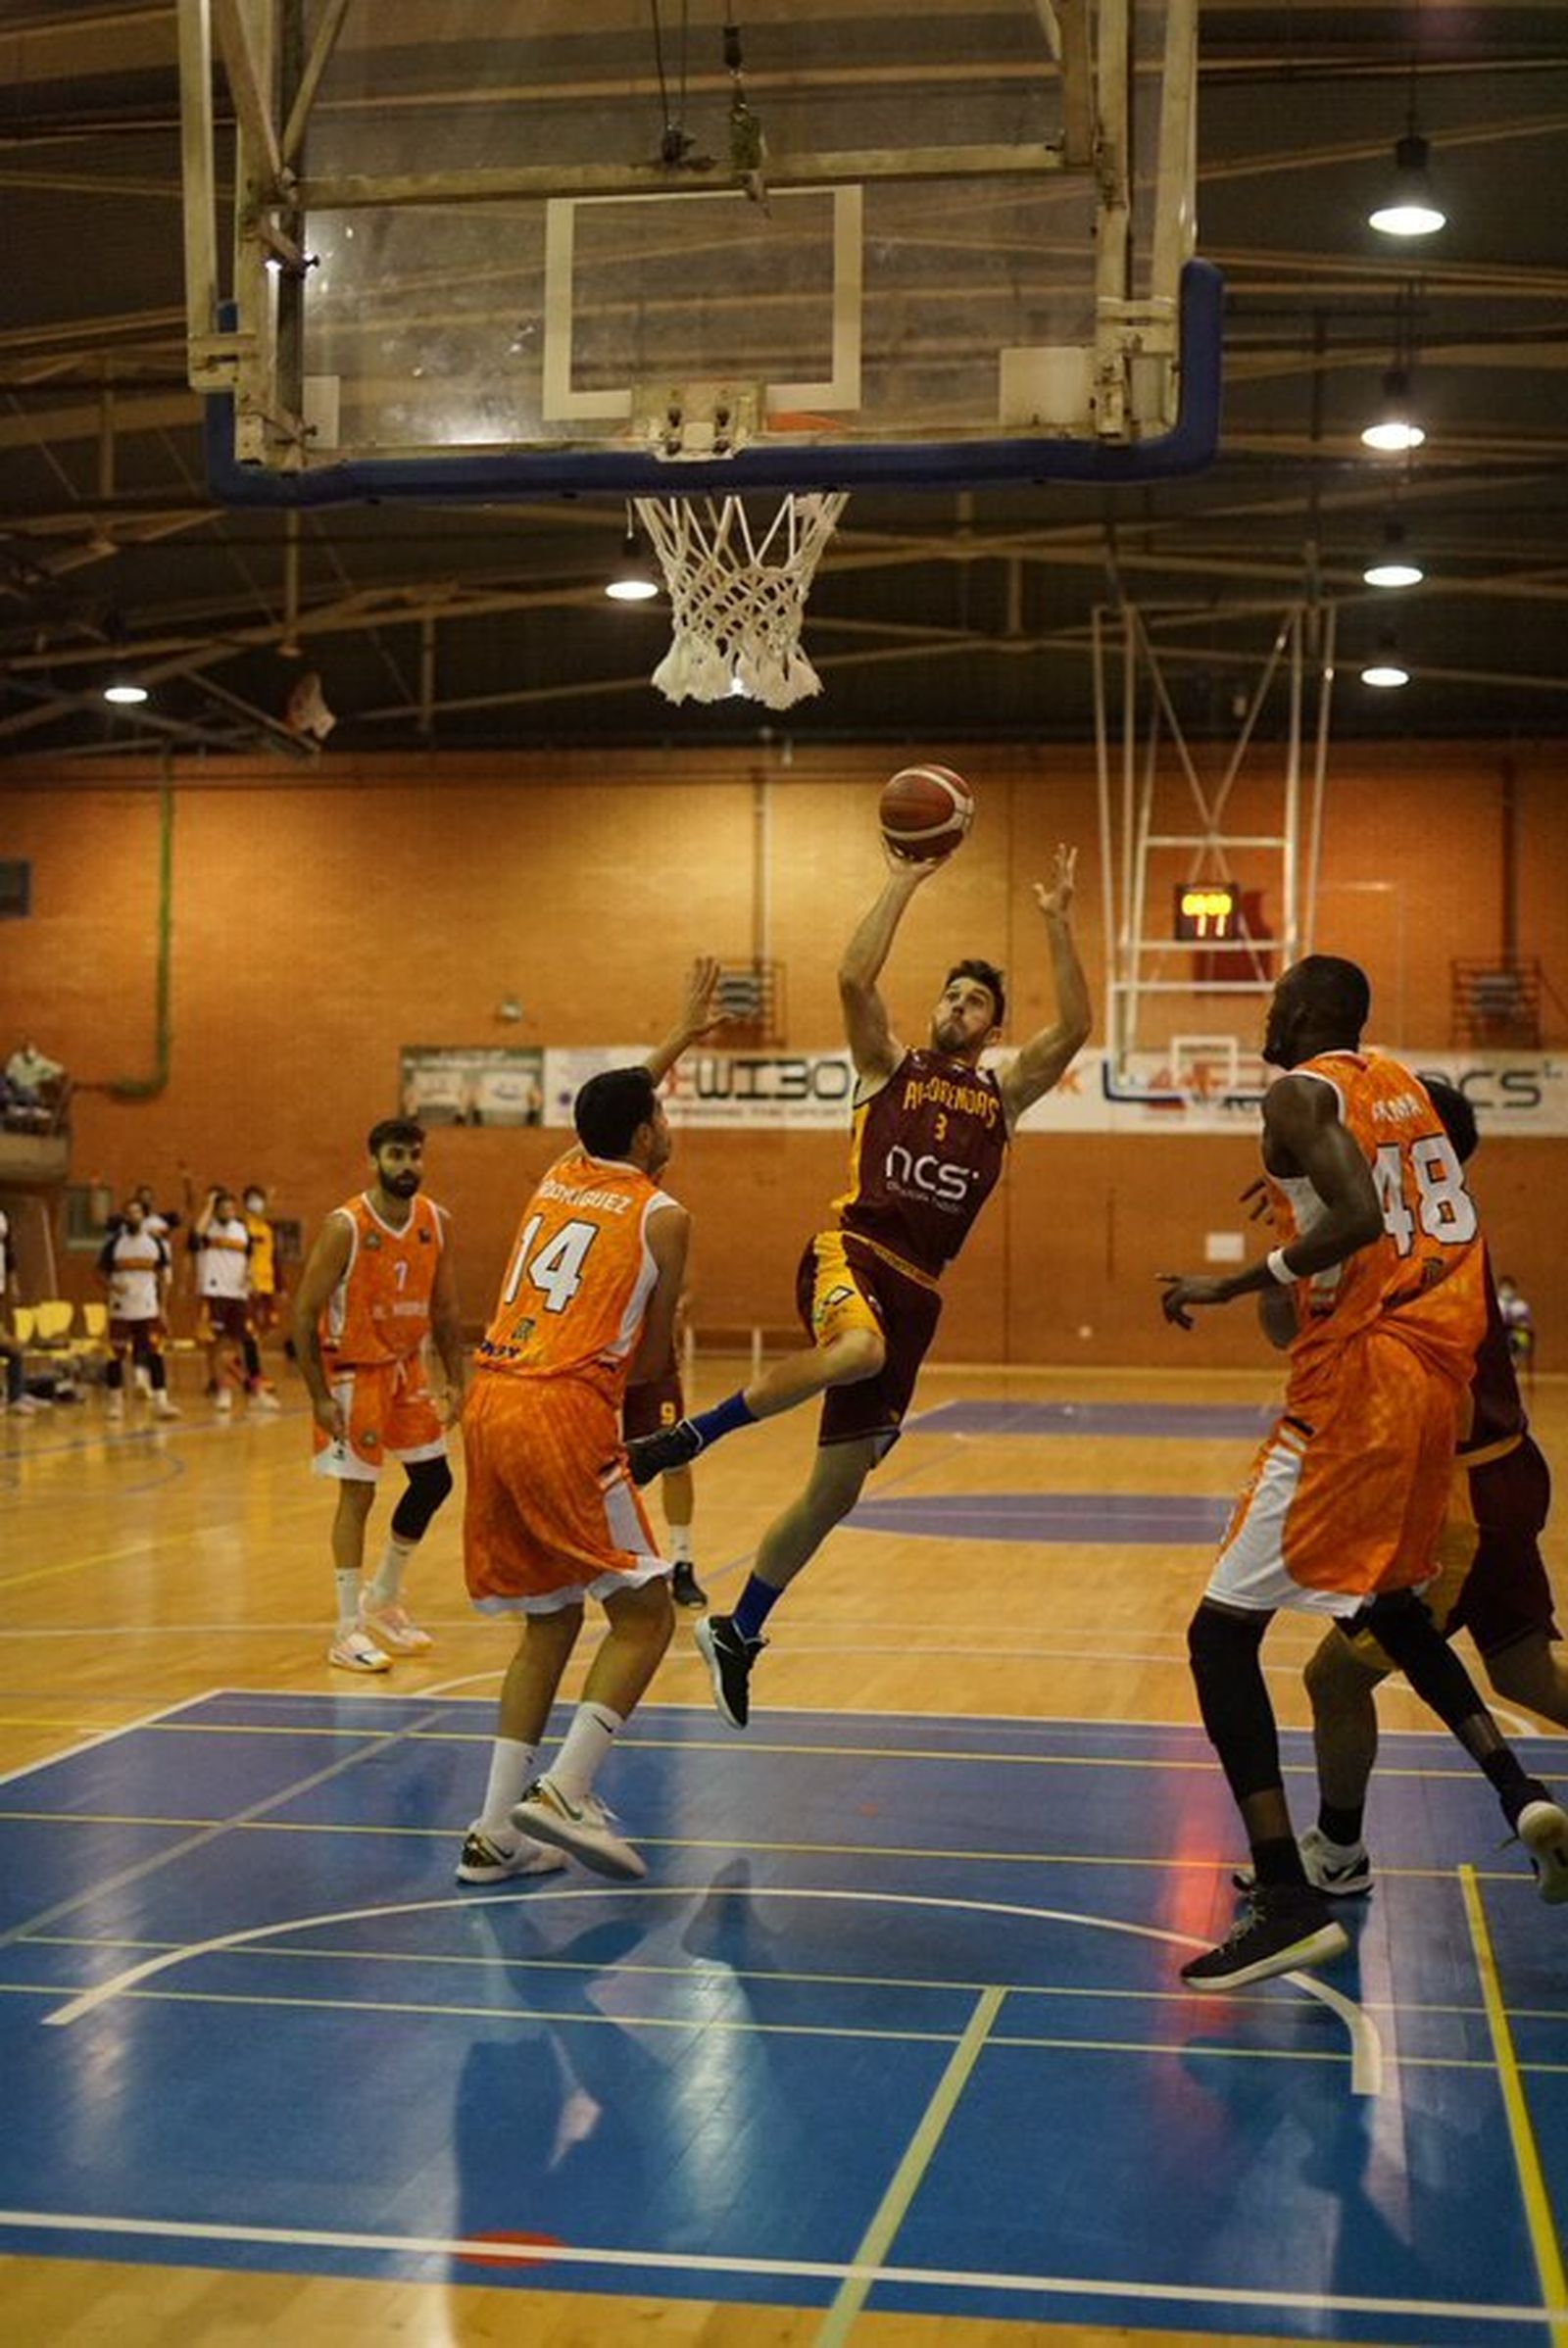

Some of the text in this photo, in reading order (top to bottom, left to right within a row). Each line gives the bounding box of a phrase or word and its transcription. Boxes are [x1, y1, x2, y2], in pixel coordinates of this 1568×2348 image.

[934, 1113, 948, 1142] 3
[1372, 1132, 1478, 1258] 48
[504, 1212, 600, 1314] 14
[660, 1401, 676, 1426] 9
